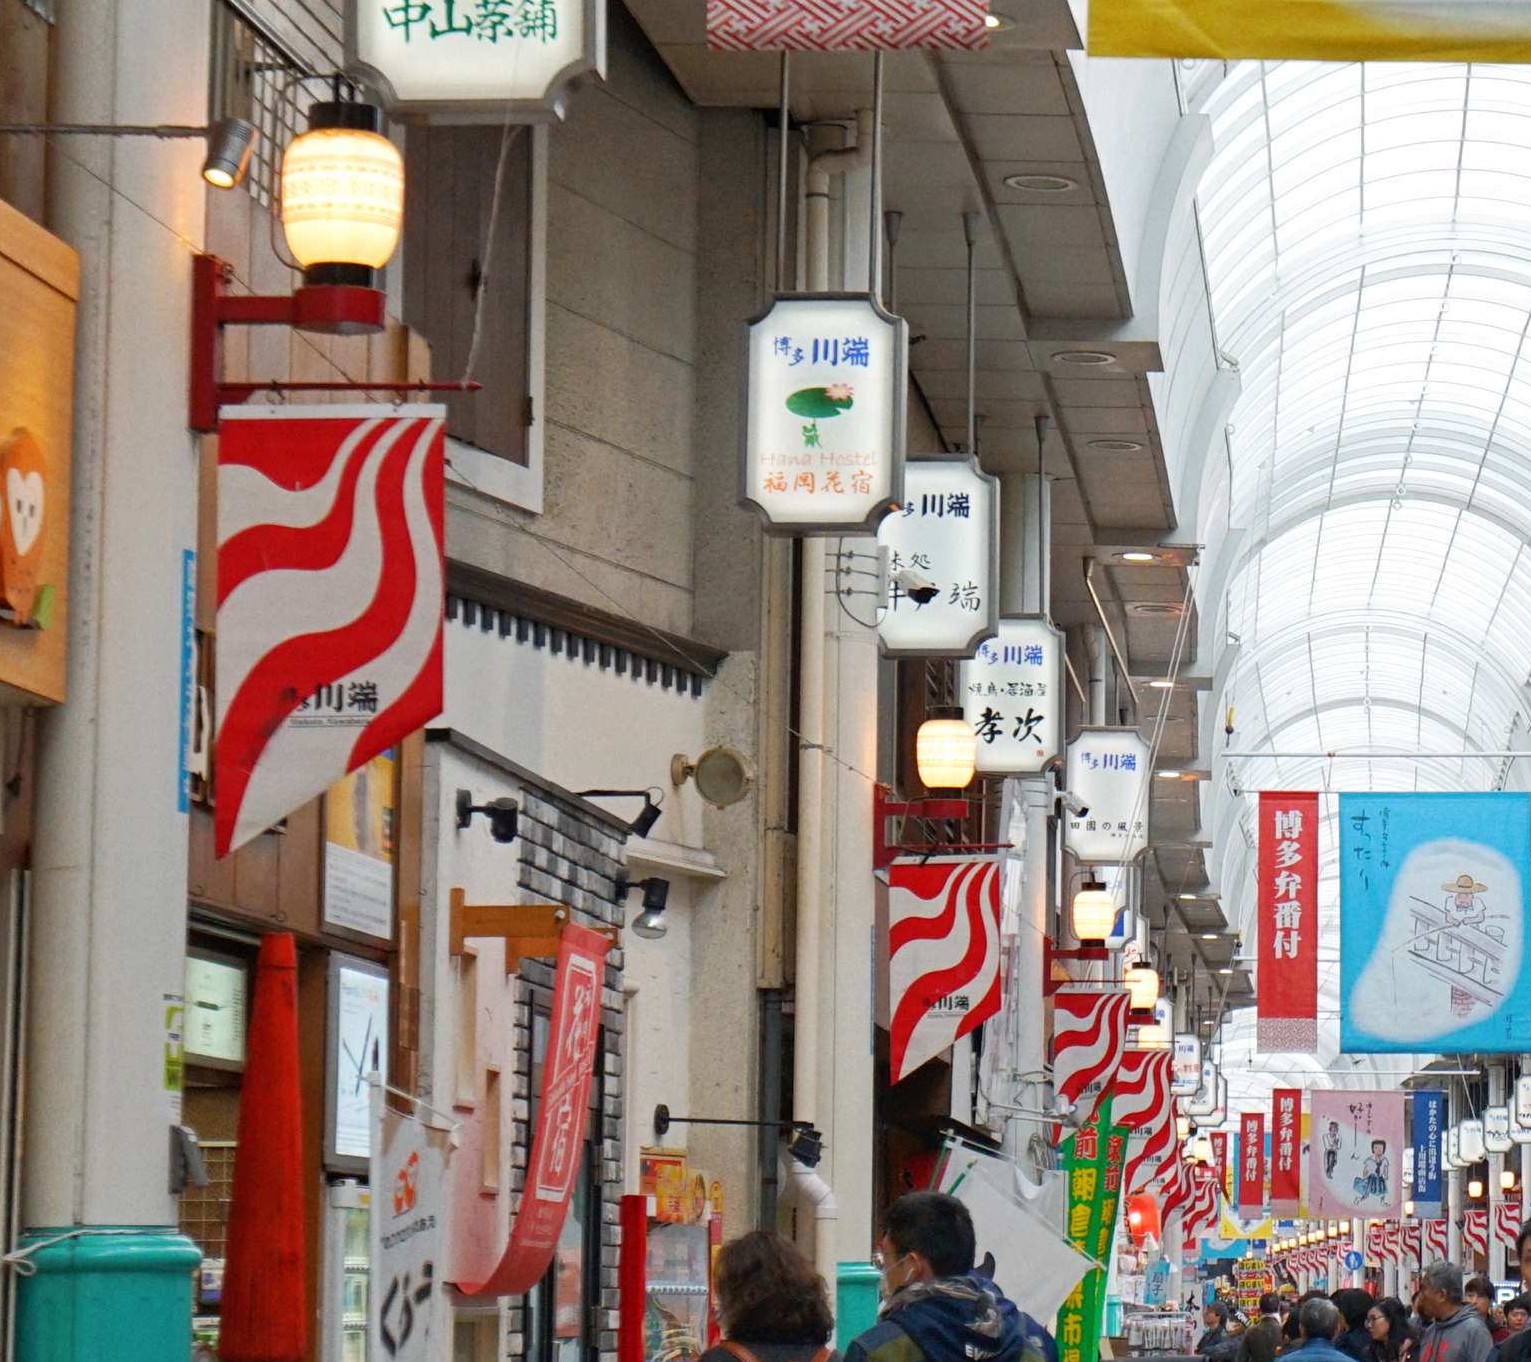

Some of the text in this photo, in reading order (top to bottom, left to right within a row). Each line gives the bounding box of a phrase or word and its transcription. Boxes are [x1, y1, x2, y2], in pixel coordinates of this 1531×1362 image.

[773, 336, 870, 367] 博多川端
[819, 451, 878, 467] Hostel
[762, 470, 874, 495] 福岡花宿
[902, 493, 971, 519] 多川端
[975, 643, 1045, 666] 博多川端
[974, 708, 1045, 746] 孝次
[1080, 752, 1137, 772] 博多川端
[1273, 809, 1304, 959] 博多弁番付
[1279, 1097, 1294, 1172] 博多弁番付
[1245, 1120, 1259, 1182] 博多弁番付
